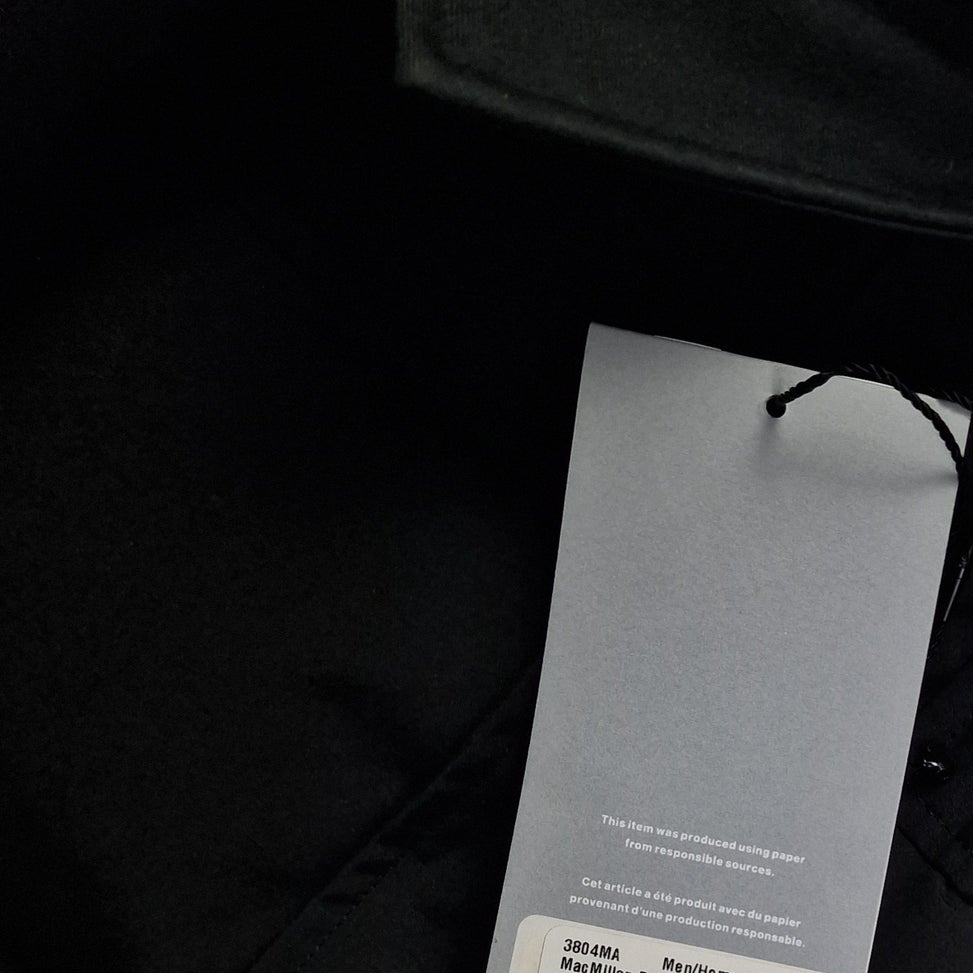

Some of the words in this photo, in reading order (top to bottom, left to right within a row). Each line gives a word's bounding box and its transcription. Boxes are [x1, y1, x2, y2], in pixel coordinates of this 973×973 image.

[601, 814, 626, 828] This
[628, 819, 654, 834] item
[656, 827, 678, 839] was
[680, 832, 737, 850] produced
[739, 843, 769, 860] using
[771, 849, 806, 865] paper
[625, 838, 653, 852] from
[655, 844, 723, 867] responsible
[725, 858, 775, 877] sources.
[568, 895, 630, 914] provenant
[631, 906, 663, 920] d'une
[665, 912, 729, 933] production
[731, 926, 806, 948] responsable.
[582, 877, 602, 889] Cet
[604, 879, 642, 897] article
[644, 891, 651, 899] a
[653, 889, 672, 903] été
[674, 894, 717, 912] produit
[718, 904, 746, 917] avec
[747, 909, 763, 920] du
[764, 912, 802, 930] papier
[563, 938, 620, 962] 3804MA
